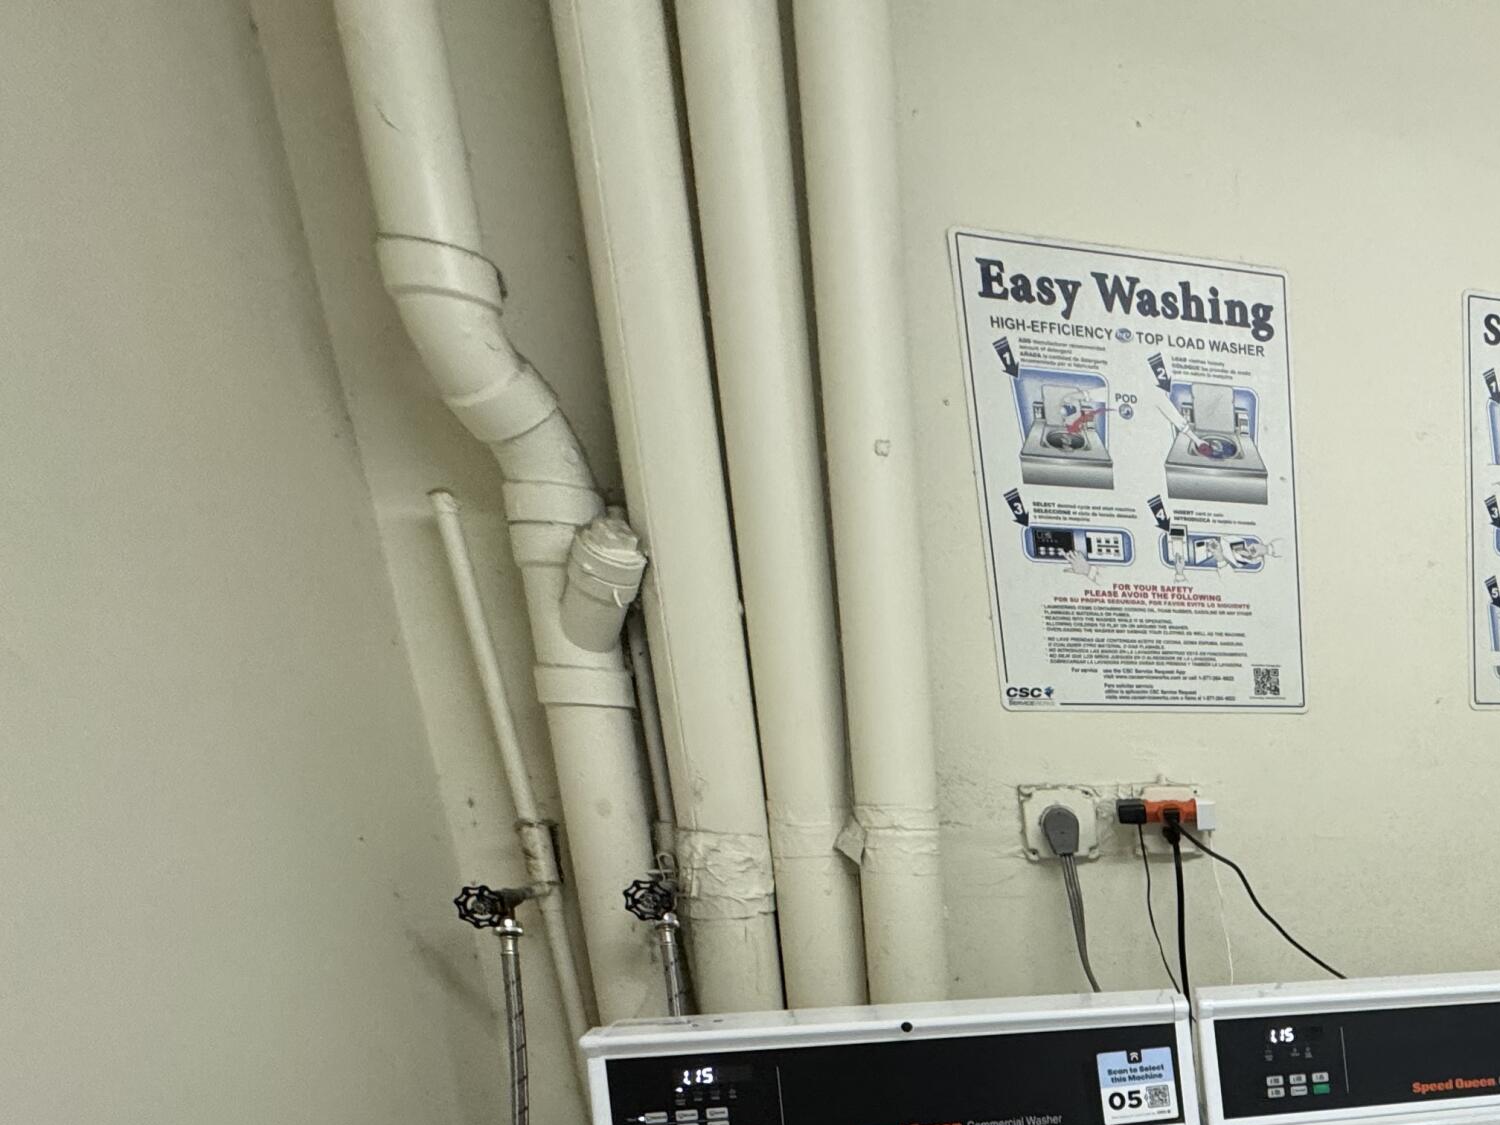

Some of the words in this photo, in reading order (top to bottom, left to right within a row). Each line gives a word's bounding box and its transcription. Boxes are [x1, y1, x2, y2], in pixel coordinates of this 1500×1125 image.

[975, 257, 1081, 319] Easy
[1091, 271, 1275, 342] Washing
[990, 315, 1113, 341] HIGH-EFFICIENCY
[1136, 331, 1164, 345] TOP
[1168, 335, 1205, 351] LOAD
[1209, 340, 1265, 357] WASHER
[1156, 367, 1168, 381] 2
[1114, 392, 1138, 405] POD
[1014, 503, 1023, 515] 3
[1113, 583, 1131, 591] FOR
[1133, 584, 1158, 592] YOUR
[1160, 585, 1193, 594] SAFETY
[1084, 589, 1118, 598] PLEASE
[1121, 591, 1149, 599] AVOID
[1152, 592, 1168, 600] THE
[1171, 593, 1222, 602] FOLLOWING
[1006, 687, 1042, 698] CSC
[1107, 1068, 1128, 1076] Scan
[1139, 1064, 1164, 1072] Select
[1111, 1076, 1127, 1084] this
[1128, 1072, 1163, 1082] Machine
[1412, 1078, 1454, 1094] Speed
[1455, 1076, 1496, 1089] Queen
[1108, 1090, 1143, 1111] 05
